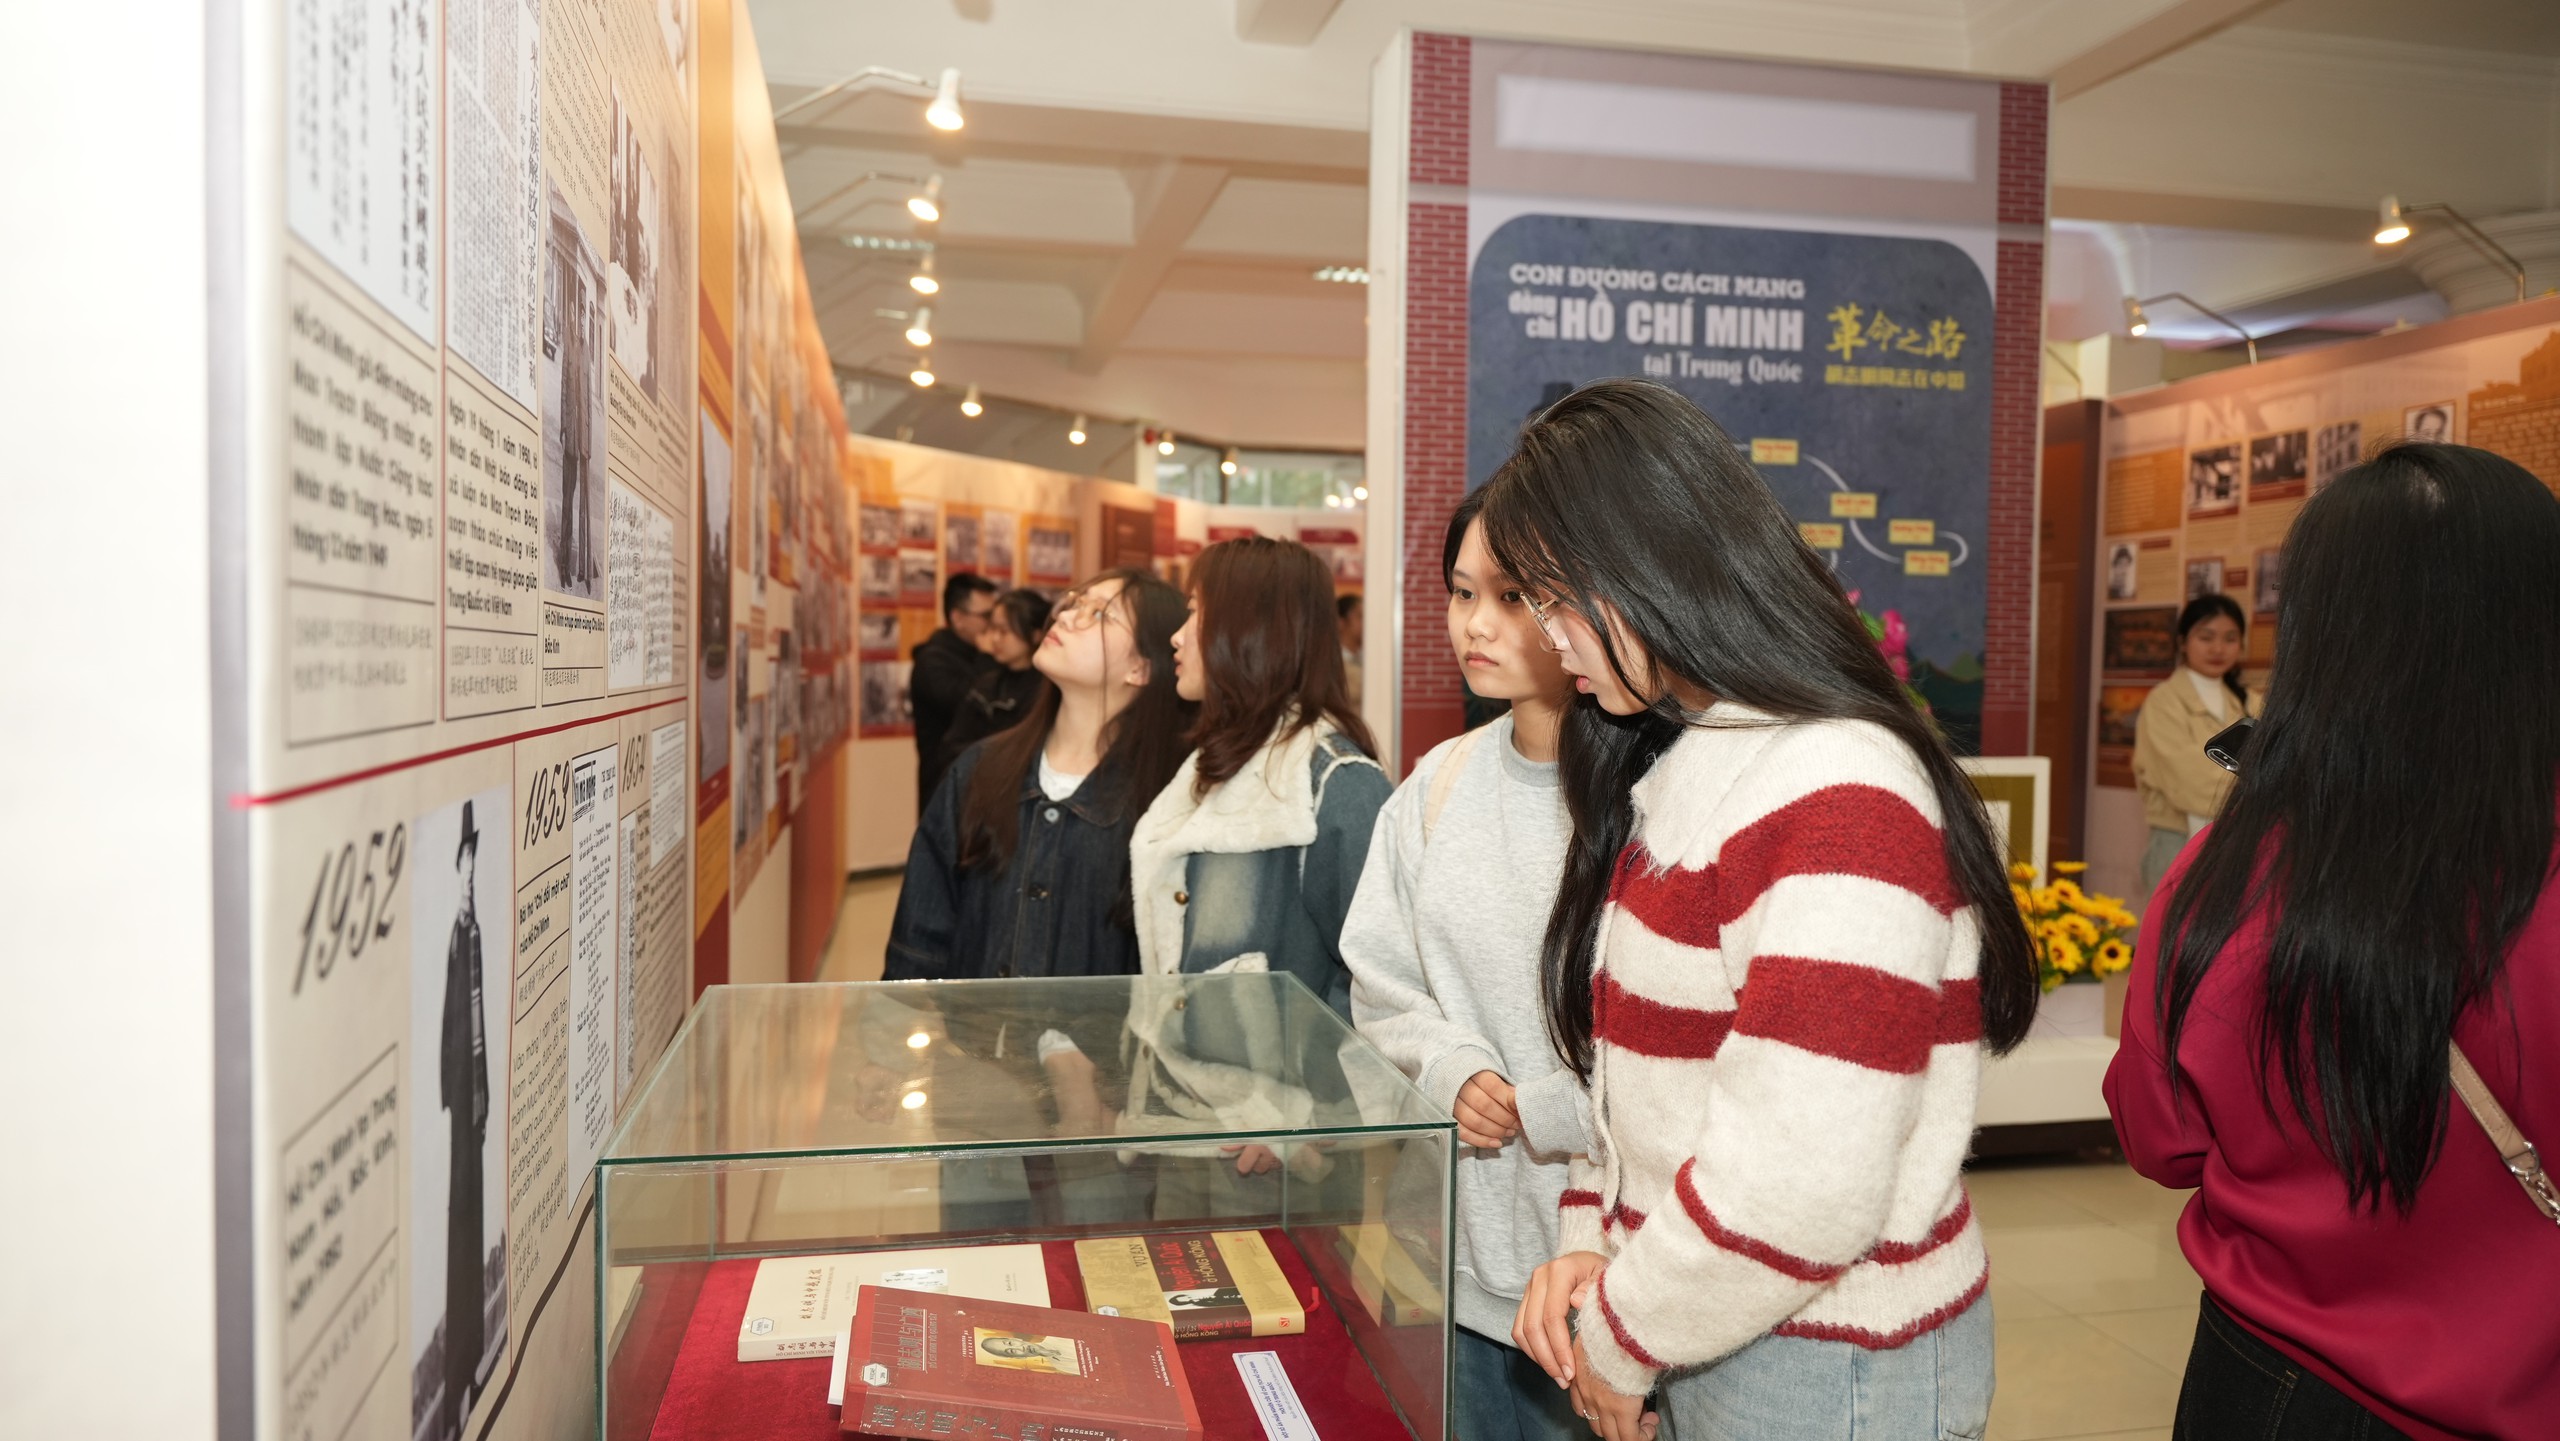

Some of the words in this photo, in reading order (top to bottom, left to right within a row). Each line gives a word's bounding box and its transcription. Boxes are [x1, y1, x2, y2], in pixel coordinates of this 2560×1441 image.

[1509, 262, 1563, 286] CON
[1660, 269, 1731, 296] CÁCH
[1733, 275, 1806, 301] MẠNG
[1508, 289, 1557, 315] đồng
[1526, 313, 1557, 339] chí
[1560, 286, 1615, 343] HỒ
[1626, 297, 1696, 346] CHÍ
[1705, 304, 1805, 351] MINH
[1825, 301, 1966, 362] 革命之路
[1676, 351, 1743, 385] Trung
[1748, 353, 1803, 383] Quốc
[622, 732, 648, 794] 1954
[523, 760, 570, 851] 1953
[291, 820, 407, 998] 1952
[1128, 1243, 1144, 1255] ÁN
[1134, 1254, 1149, 1267] VỤ
[1187, 1239, 1208, 1258] KÔNG
[1180, 1330, 1199, 1339] HỒNG
[1200, 1329, 1219, 1337] KÔNG
[1198, 1321, 1225, 1331] Nguyễn
[1233, 1319, 1252, 1328] Quốc
